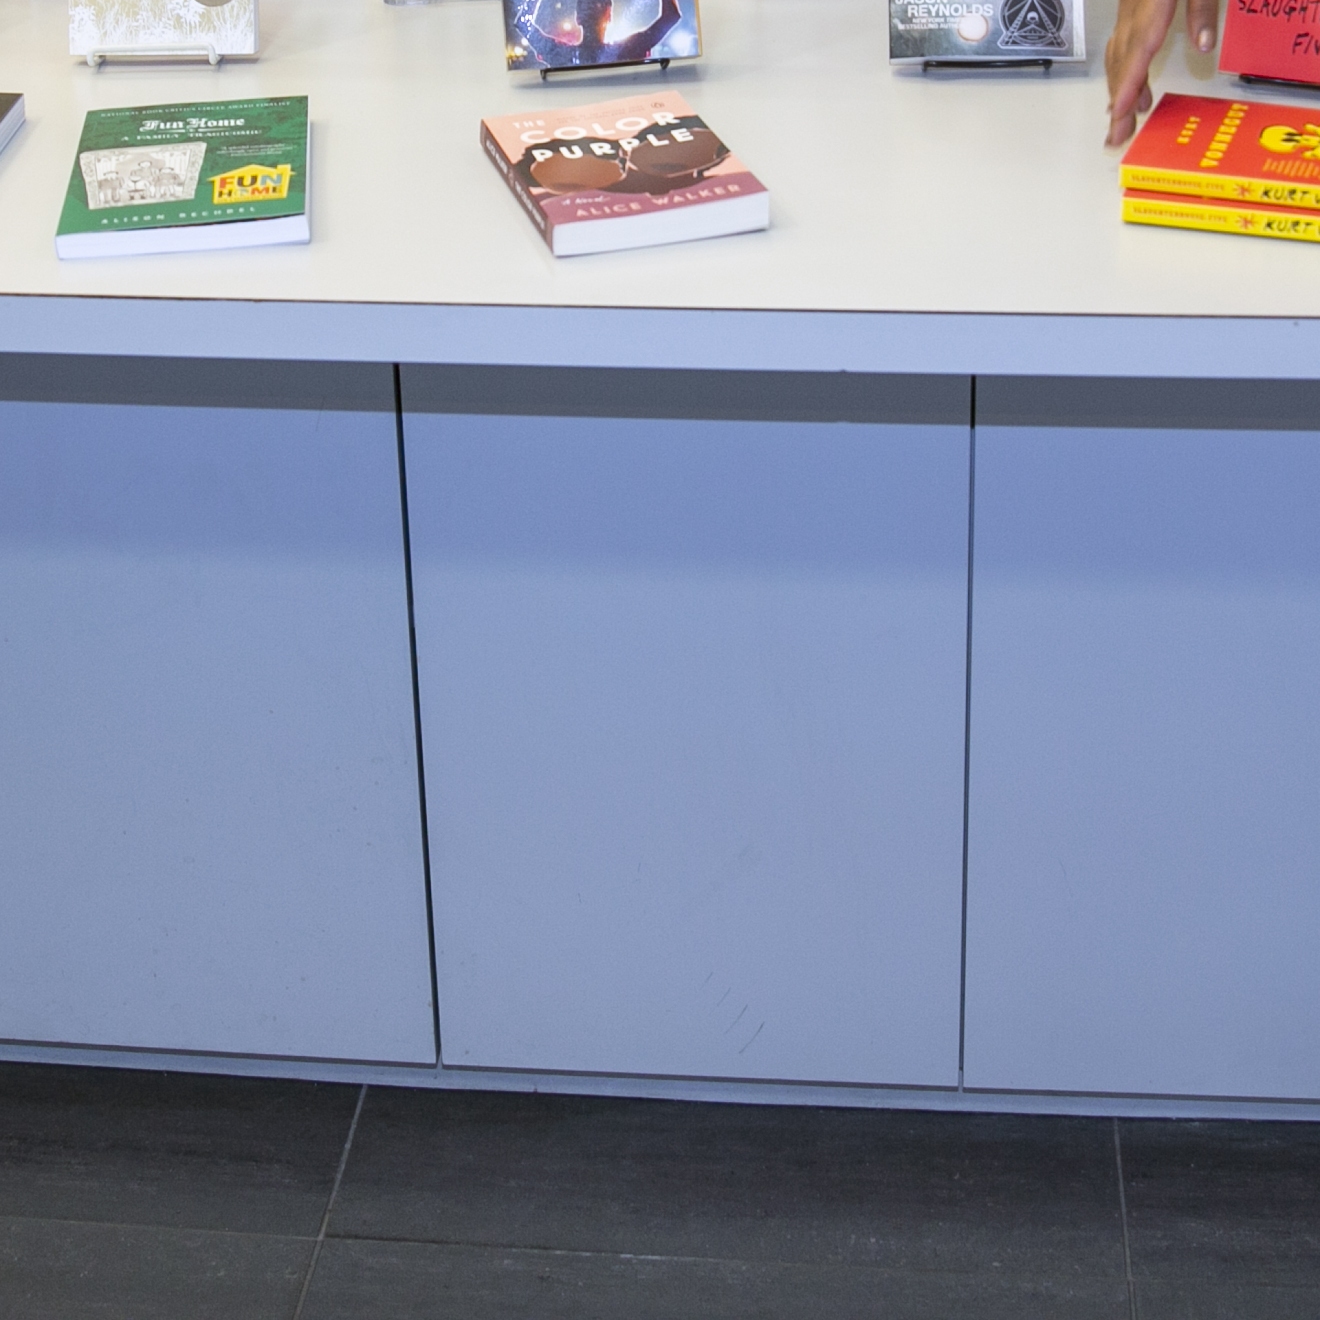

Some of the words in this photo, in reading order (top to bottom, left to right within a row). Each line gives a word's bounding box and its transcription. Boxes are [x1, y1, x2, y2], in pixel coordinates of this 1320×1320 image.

[907, 3, 994, 18] REYNOLDS
[140, 119, 186, 133] Fun
[186, 118, 245, 130] Home
[520, 111, 681, 144] COLOR
[531, 127, 694, 163] PURPLE
[219, 173, 283, 190] FUN
[218, 185, 283, 199] HOME
[1260, 186, 1308, 203] KURT
[576, 201, 643, 219] ALICE
[651, 183, 742, 207] WALKER
[1263, 219, 1312, 236] KURT
